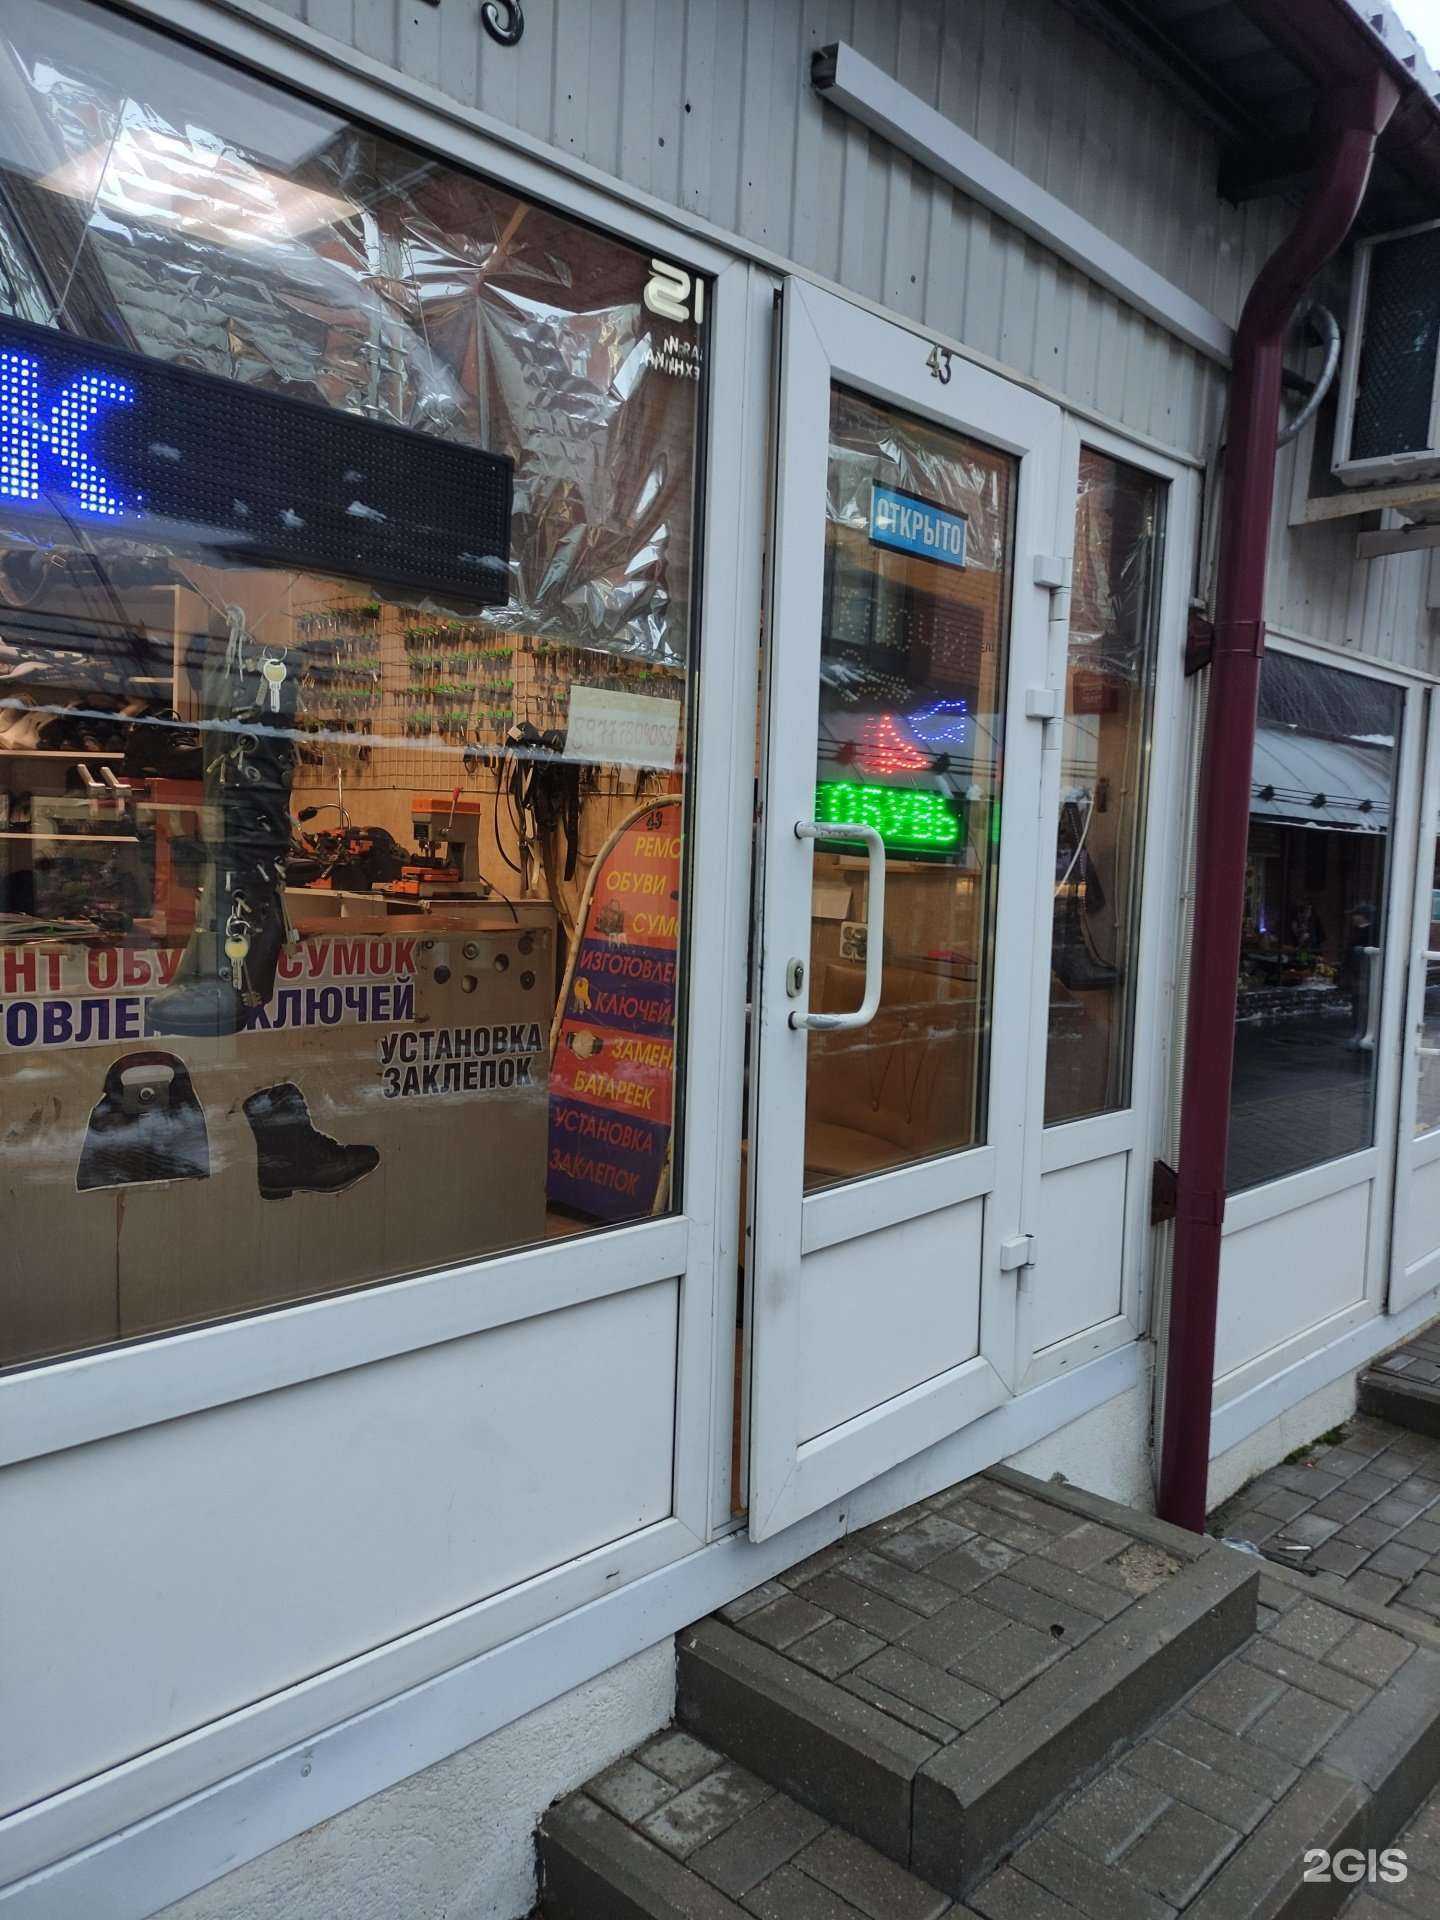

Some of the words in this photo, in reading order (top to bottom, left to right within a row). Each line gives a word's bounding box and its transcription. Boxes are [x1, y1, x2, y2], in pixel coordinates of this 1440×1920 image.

[925, 344, 952, 385] 43
[876, 498, 962, 556] ОТКРЫТО
[634, 836, 680, 859] РЕМО
[606, 871, 667, 896] ОБУВИ
[87, 947, 186, 991] ОБУ
[277, 938, 417, 979] СУМОК
[579, 951, 676, 985] ИЗГОТОВЛЕ
[594, 992, 672, 1024] КЛЮЧЕЙ
[381, 1023, 543, 1065] УСТАНОВКА
[611, 1037, 673, 1071] ЗАМЕН
[383, 1057, 532, 1098] ЗАКЛЕПОК
[573, 1070, 655, 1110] БАТАРЕЕК
[554, 1105, 654, 1152] УСТАНОВКА
[549, 1146, 640, 1196] ЗАКЛЕПОК
